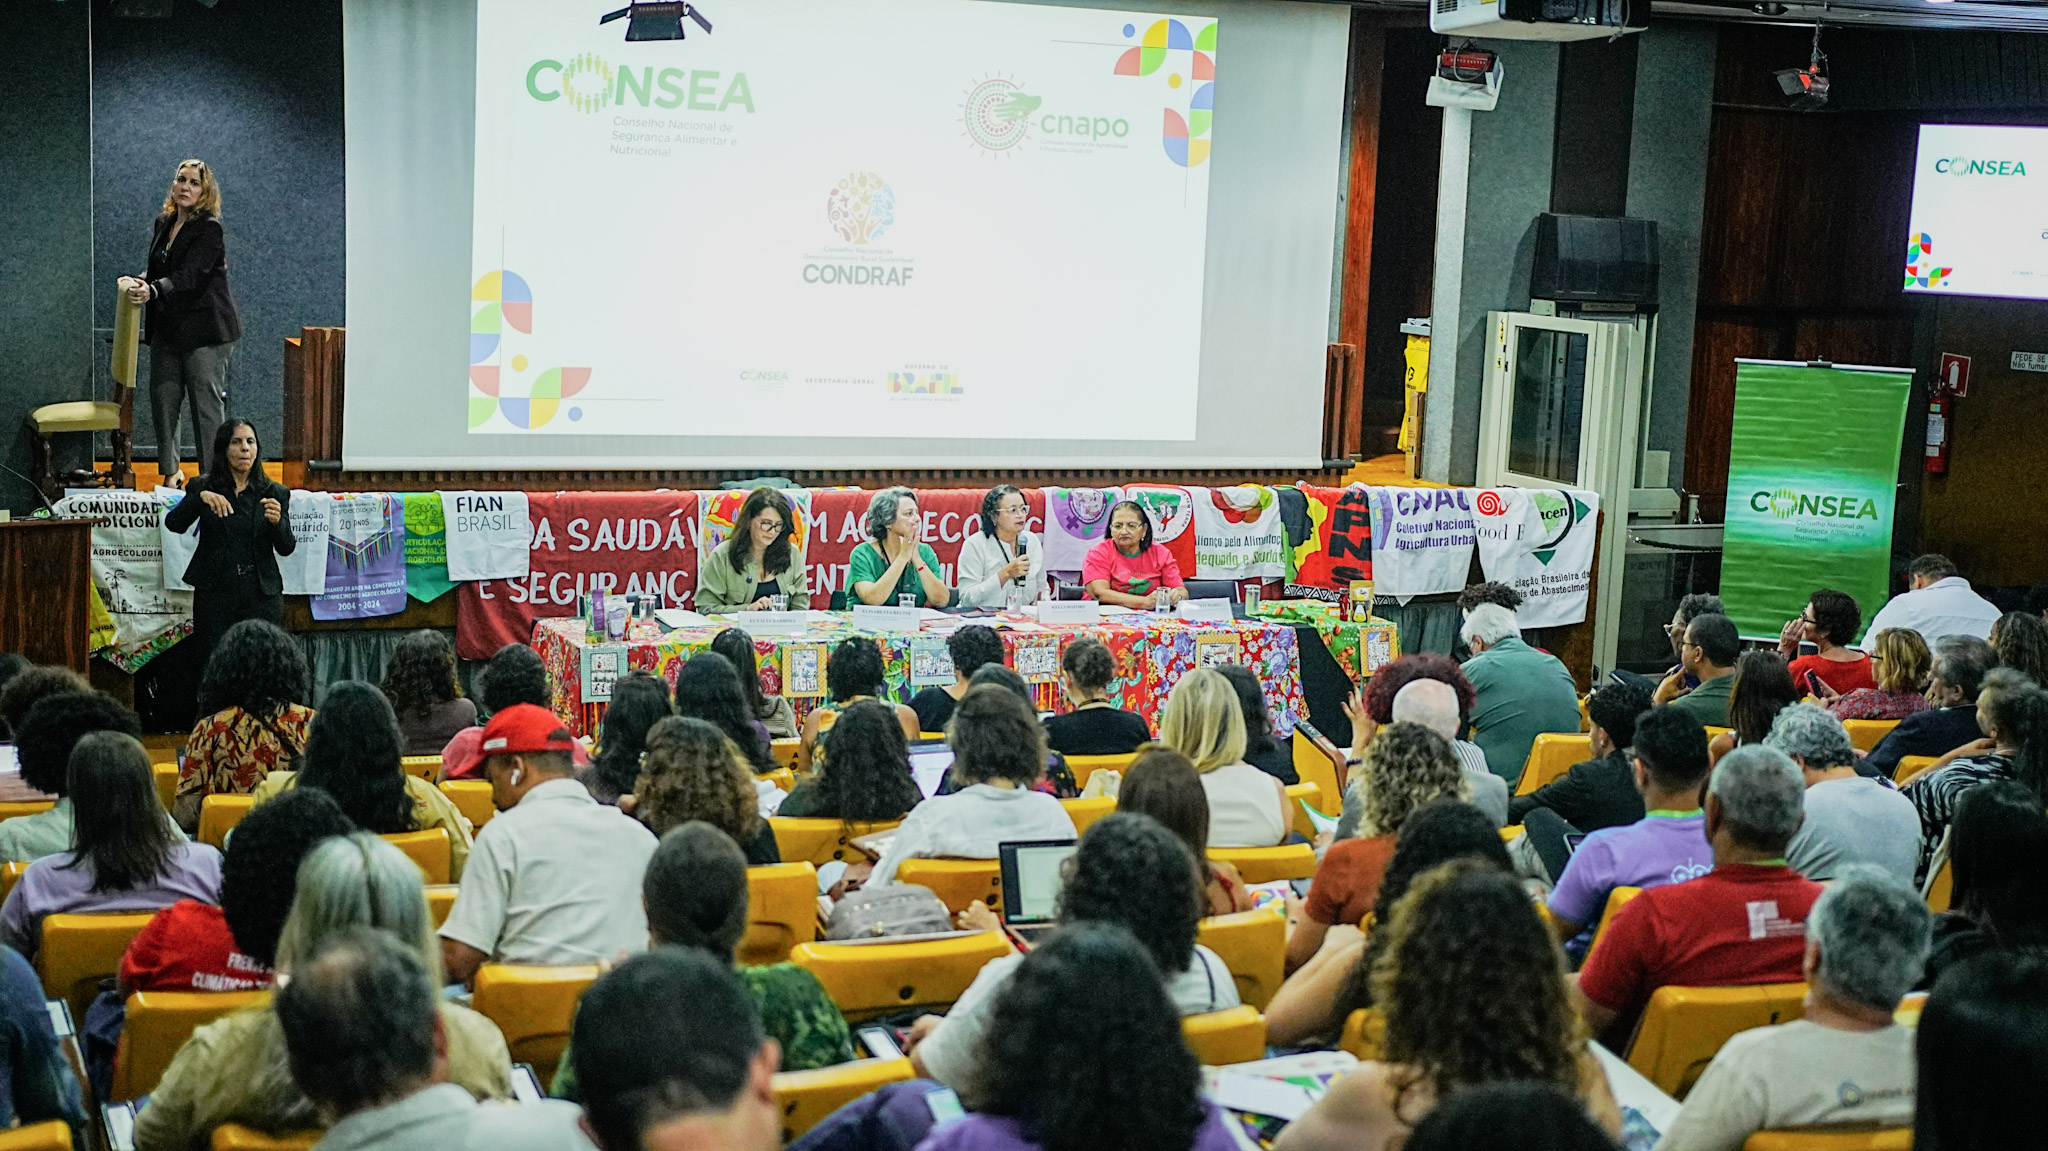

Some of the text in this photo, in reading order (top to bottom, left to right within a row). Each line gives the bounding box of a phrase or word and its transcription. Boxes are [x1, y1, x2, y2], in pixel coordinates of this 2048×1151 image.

[526, 53, 756, 114] CONSEA
[613, 116, 733, 132] Conselho Nacional de
[1040, 114, 1129, 142] cnapo
[611, 130, 670, 143] Segurança
[674, 134, 727, 146] Alimentar
[610, 144, 671, 157] Nutricional
[1935, 156, 2026, 177] CONSEA
[856, 247, 884, 255] Nacional
[803, 263, 914, 287] CONDRAF
[740, 370, 789, 382] CONSEA
[887, 372, 964, 394] BRASIL
[456, 496, 503, 513] FIAN
[1750, 488, 1878, 520] CONSEA
[339, 518, 370, 531] 20 ANOS
[457, 514, 517, 532] BRASIL
[1396, 521, 1433, 534] Coletivo
[1827, 522, 1855, 530] Nacional
[1224, 536, 1241, 548] pela
[1395, 537, 1449, 551] Agricultura
[93, 549, 163, 557] AGROECOLOGIA
[1243, 554, 1249, 565] e
[1541, 572, 1579, 584] Brasileira
[1529, 588, 1539, 597] de
[338, 602, 356, 611] 2004
[363, 600, 380, 610] 2024
